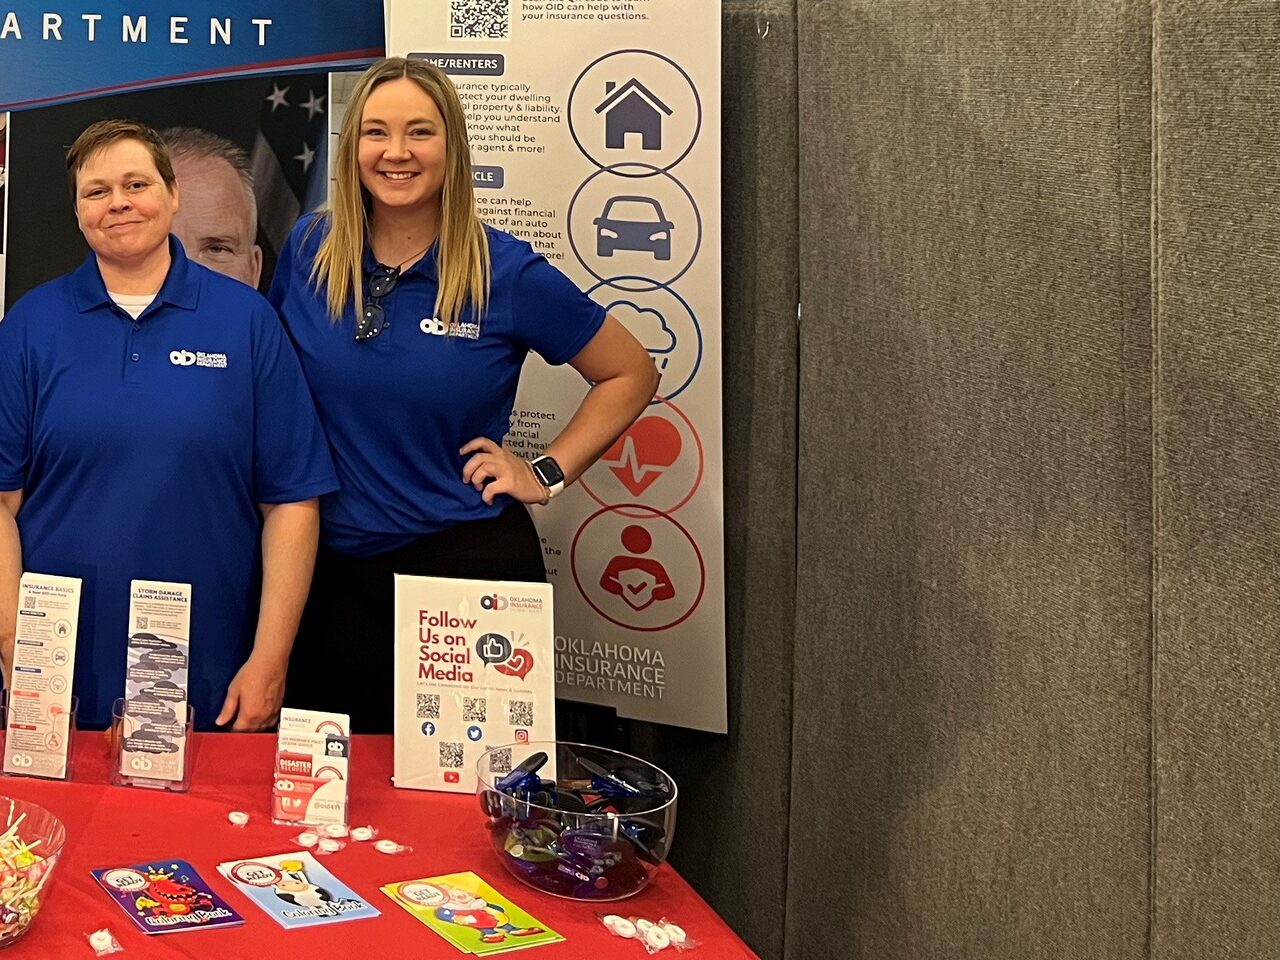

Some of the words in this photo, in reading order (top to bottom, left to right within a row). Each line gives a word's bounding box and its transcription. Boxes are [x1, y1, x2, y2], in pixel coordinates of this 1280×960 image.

[521, 13, 544, 21] your
[546, 11, 594, 20] insurance
[596, 11, 648, 21] questions.
[522, 3, 543, 11] how
[545, 3, 564, 11] OID
[587, 3, 609, 12] help
[611, 2, 634, 11] with
[485, 95, 507, 103] your
[509, 93, 551, 104] dwelling
[472, 104, 514, 113] property
[515, 104, 522, 112] &
[525, 103, 562, 114] liability.
[509, 596, 543, 604] OKLAHOMA
[509, 602, 543, 610] INSURANCE
[419, 609, 478, 629] Follow
[419, 627, 439, 644] Us
[443, 634, 466, 646] on
[419, 645, 470, 665] Social
[554, 635, 664, 666] OKLAHOMA
[418, 662, 474, 683] Media
[555, 653, 664, 685] INSURANCE
[555, 670, 665, 700] DEPARTMENT
